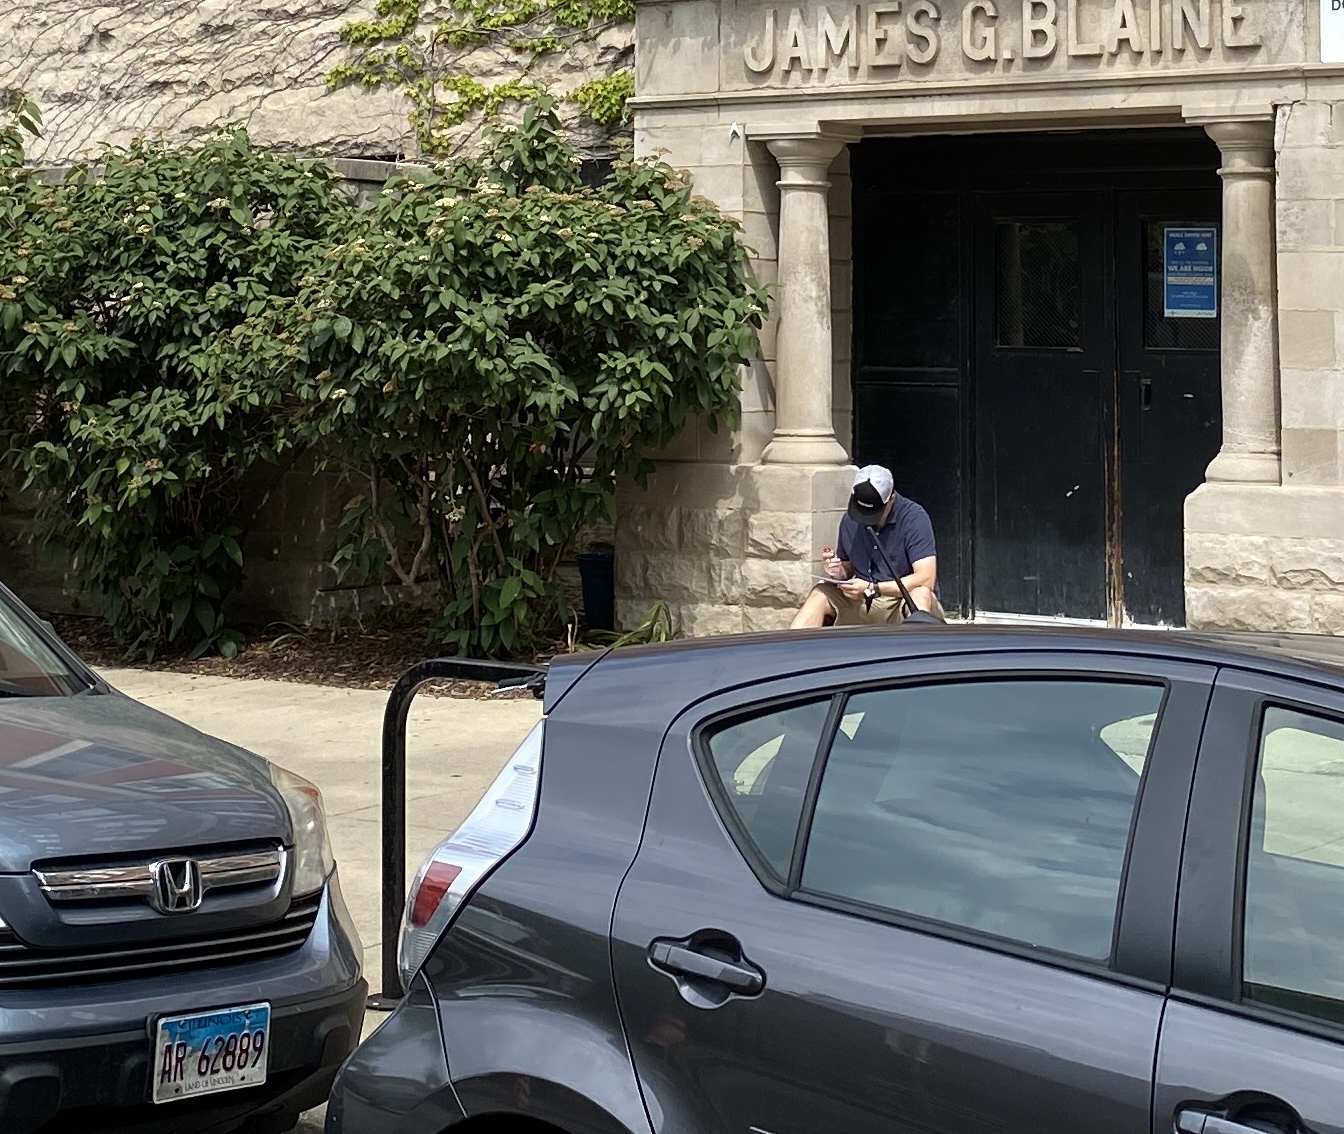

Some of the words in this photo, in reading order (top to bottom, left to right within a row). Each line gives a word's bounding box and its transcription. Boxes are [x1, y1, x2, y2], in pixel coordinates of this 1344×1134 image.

[743, 0, 942, 76] JAMES
[160, 1041, 187, 1084] AR
[197, 1029, 265, 1077] 62889
